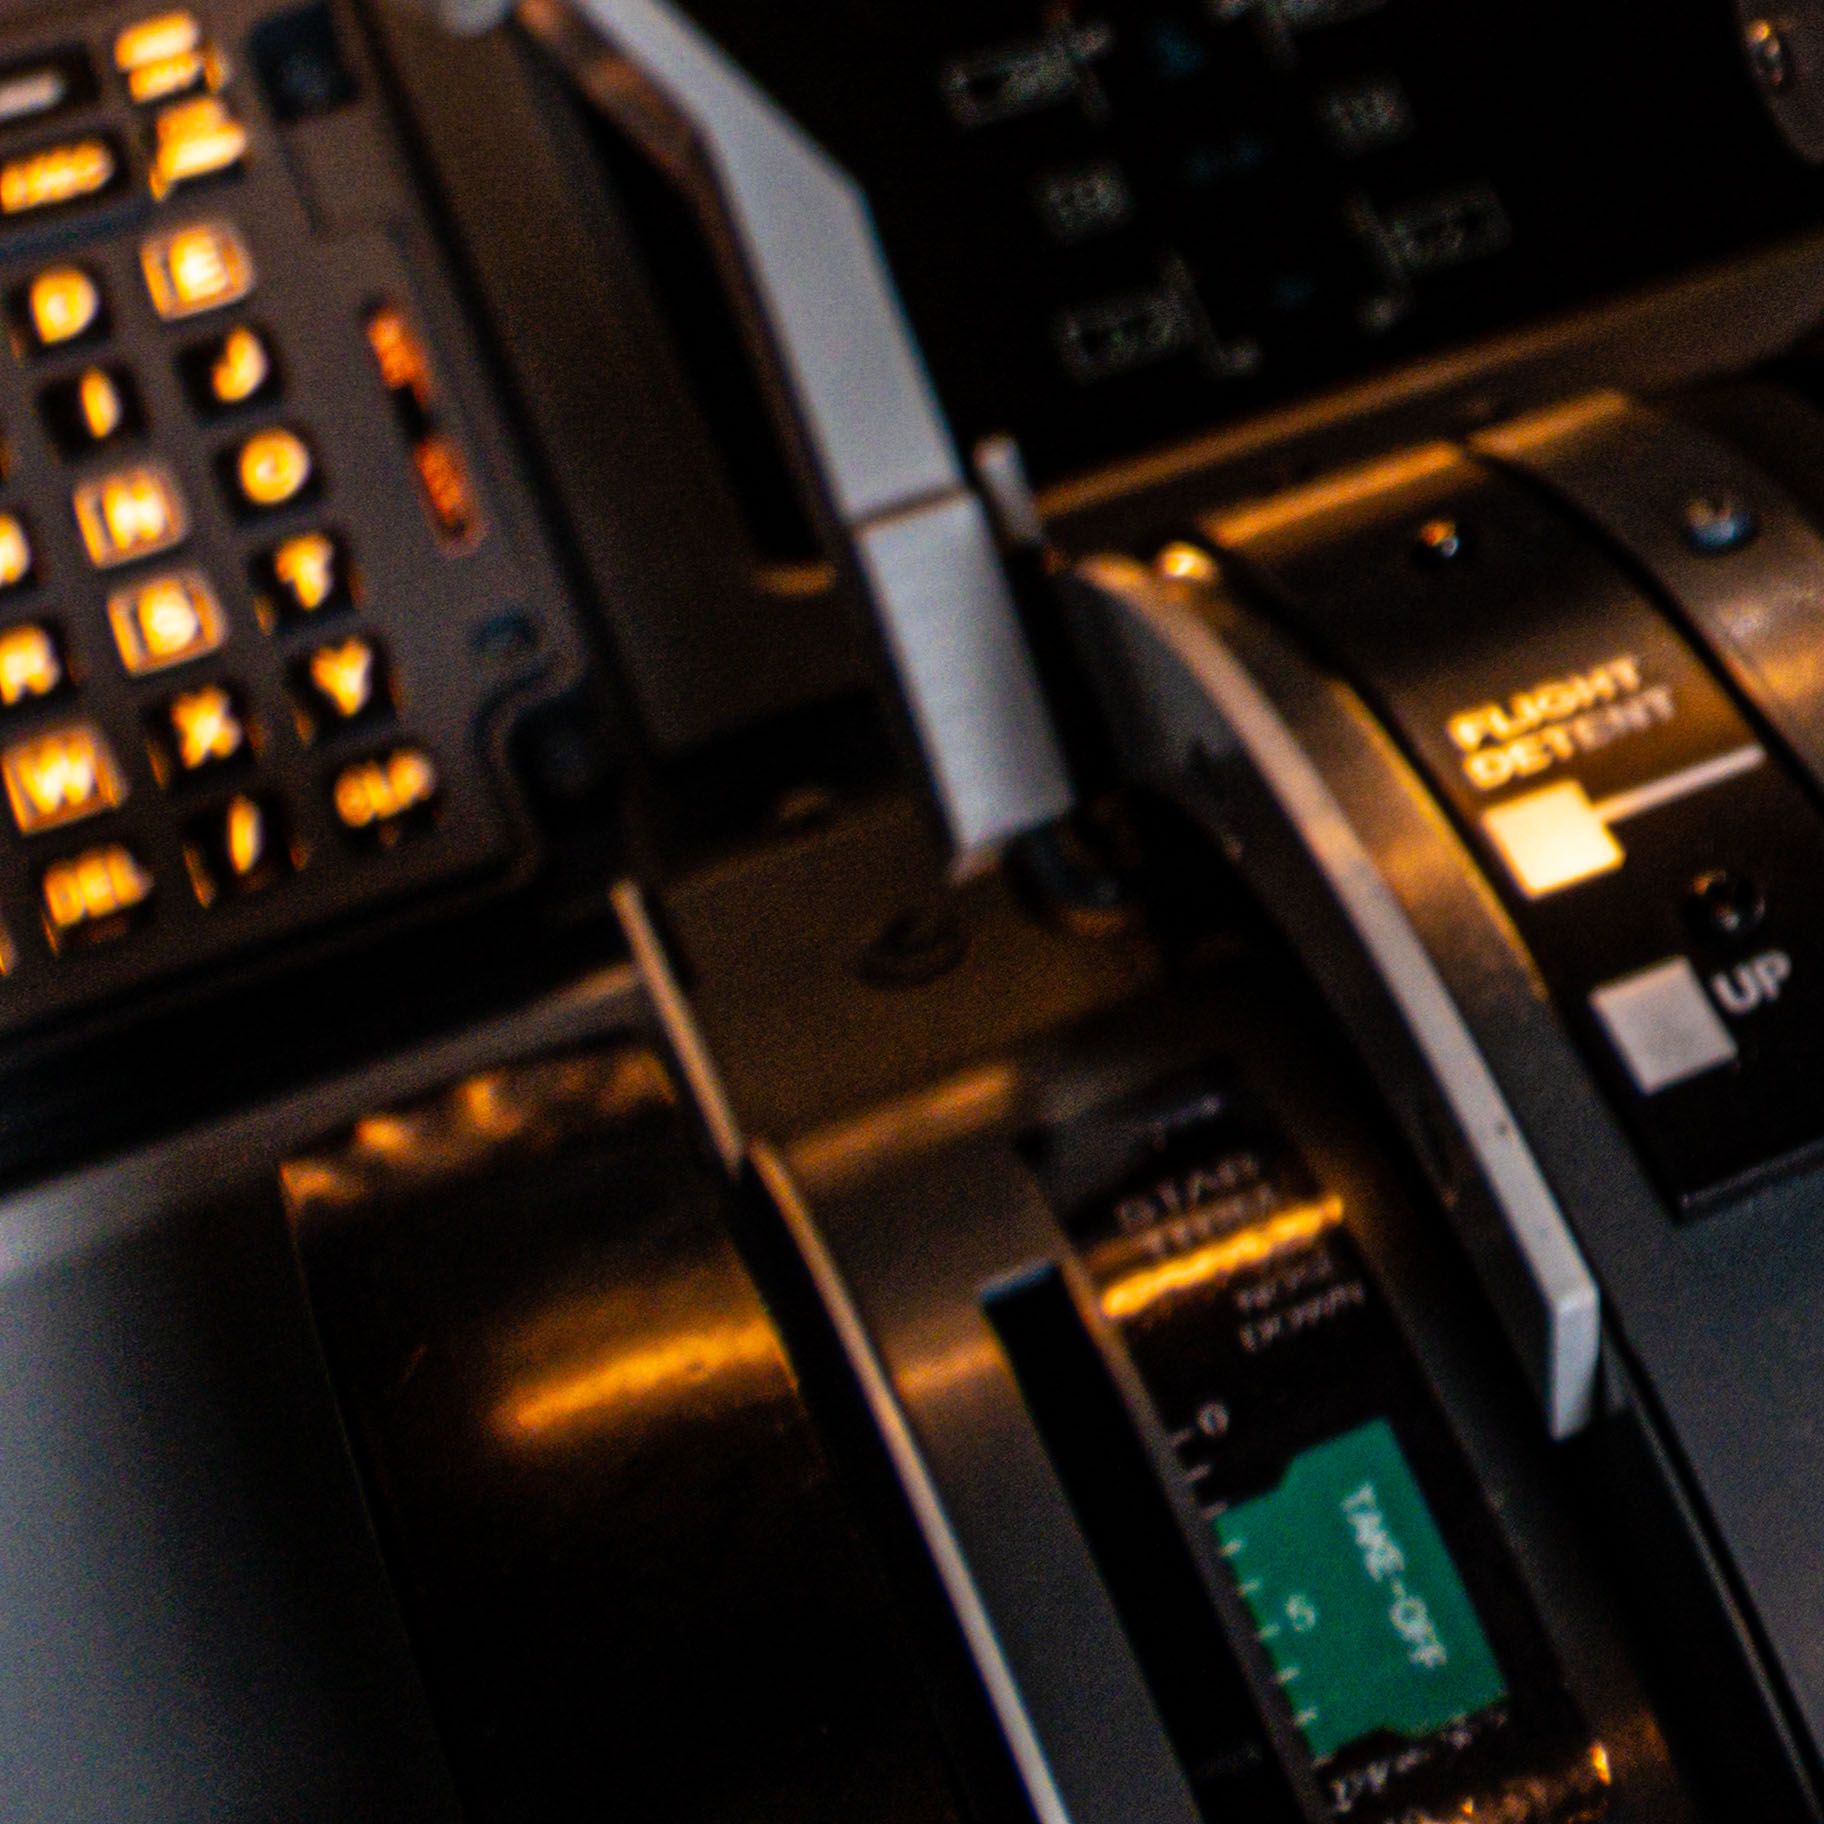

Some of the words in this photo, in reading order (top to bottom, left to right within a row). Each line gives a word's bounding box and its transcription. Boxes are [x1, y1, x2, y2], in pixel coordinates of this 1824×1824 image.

[1447, 656, 1642, 752] FLIGHT
[1462, 684, 1675, 792] DETENT
[1711, 950, 1792, 1016] UP
